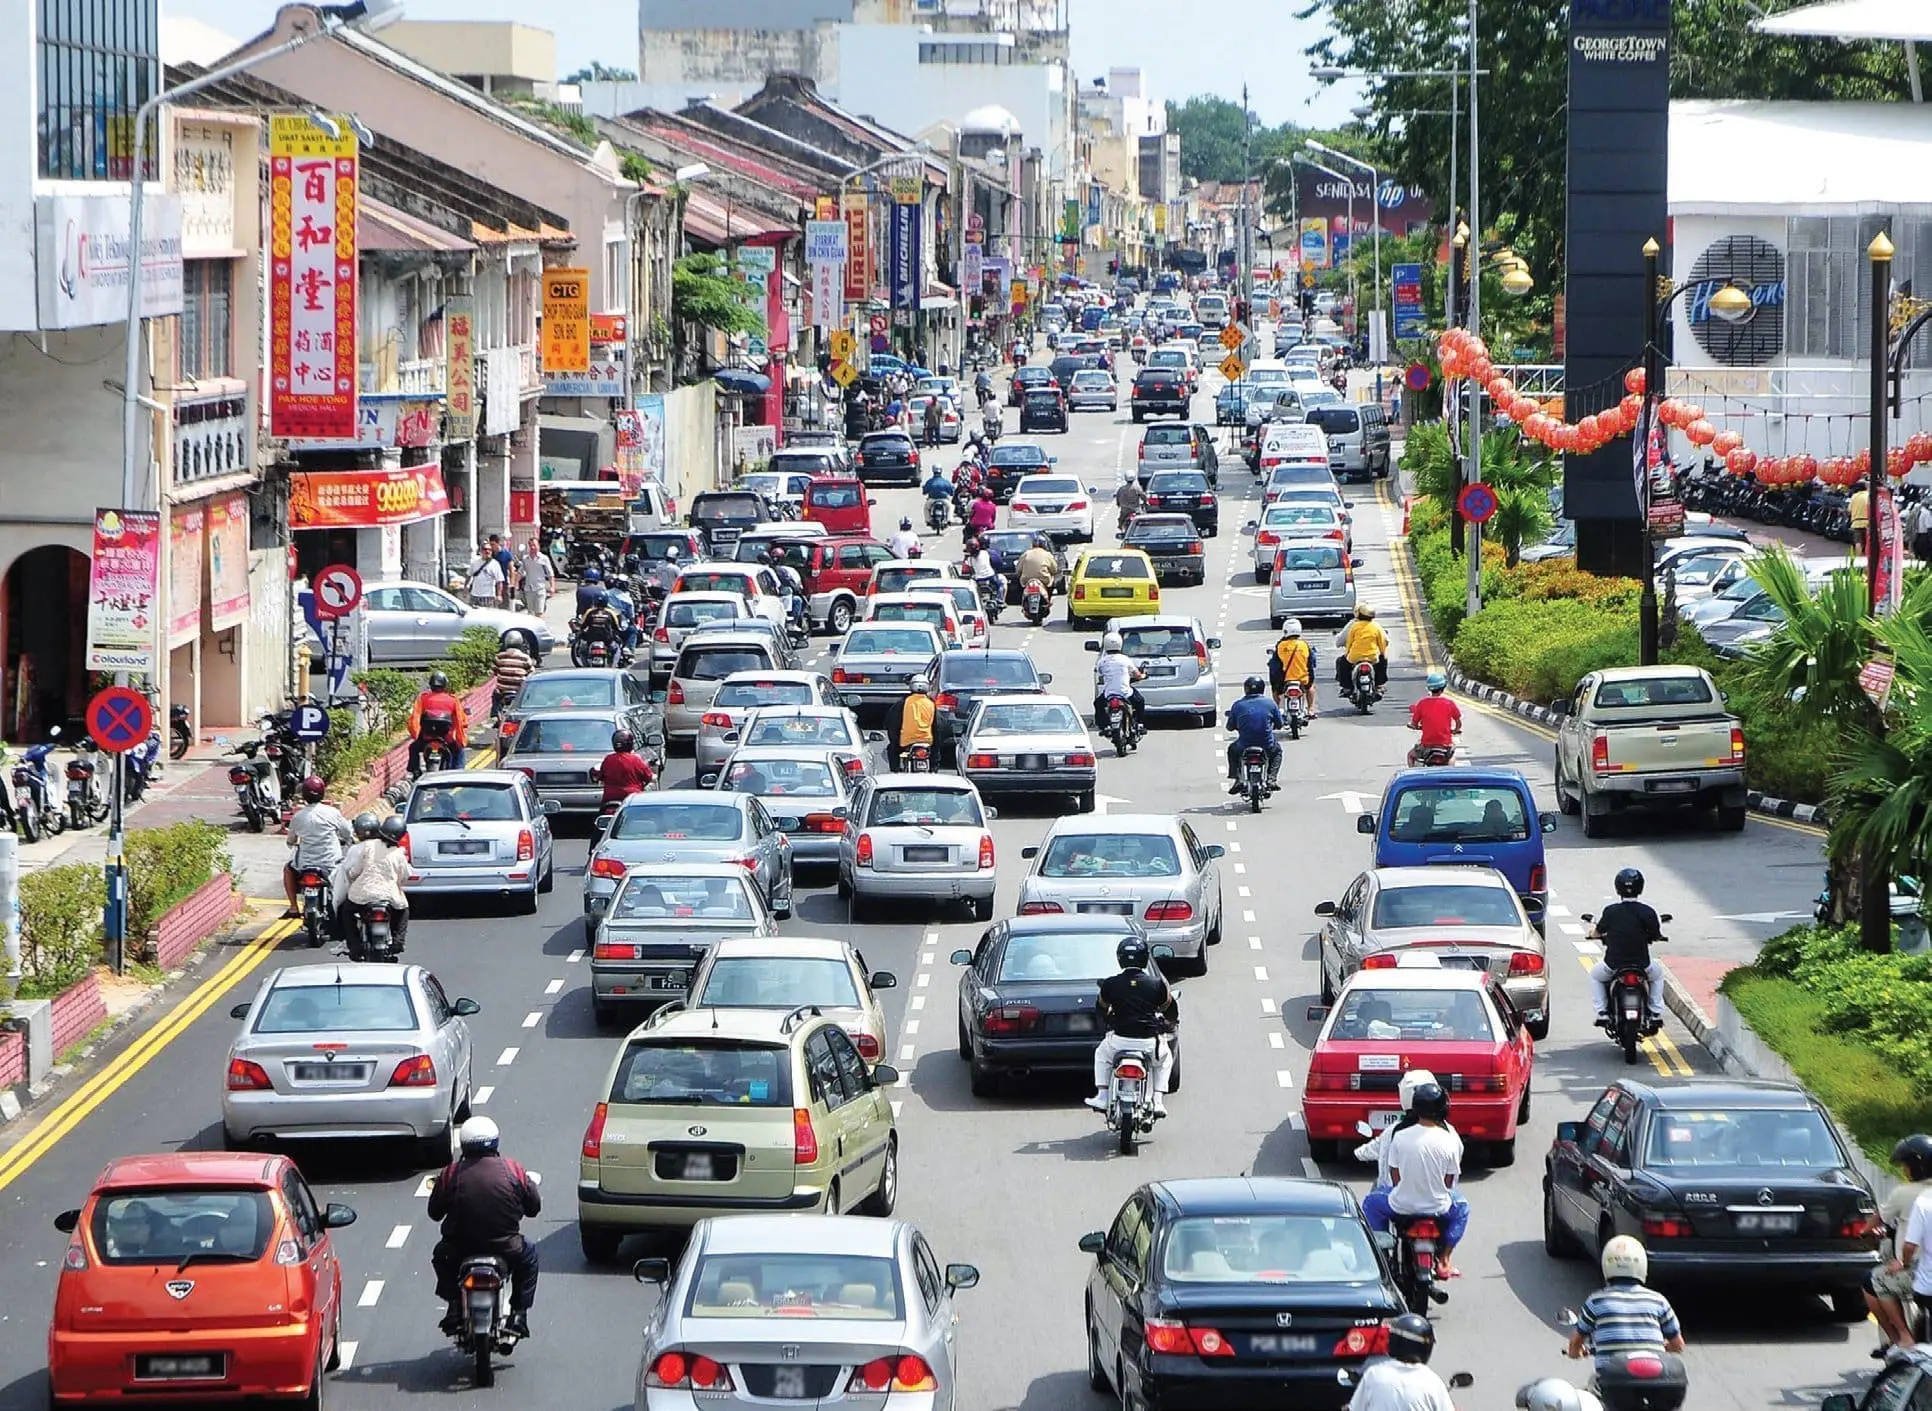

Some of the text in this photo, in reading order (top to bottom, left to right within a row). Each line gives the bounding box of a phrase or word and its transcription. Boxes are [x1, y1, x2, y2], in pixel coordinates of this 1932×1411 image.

[1584, 50, 1657, 62] WHITE COFFEE
[295, 160, 332, 311] 百和堂
[899, 205, 909, 282] MICHELIN
[552, 284, 579, 297] CTG
[547, 382, 620, 393] COMMERCIAL UNION
[322, 395, 348, 405] TONG
[301, 707, 322, 729] P
